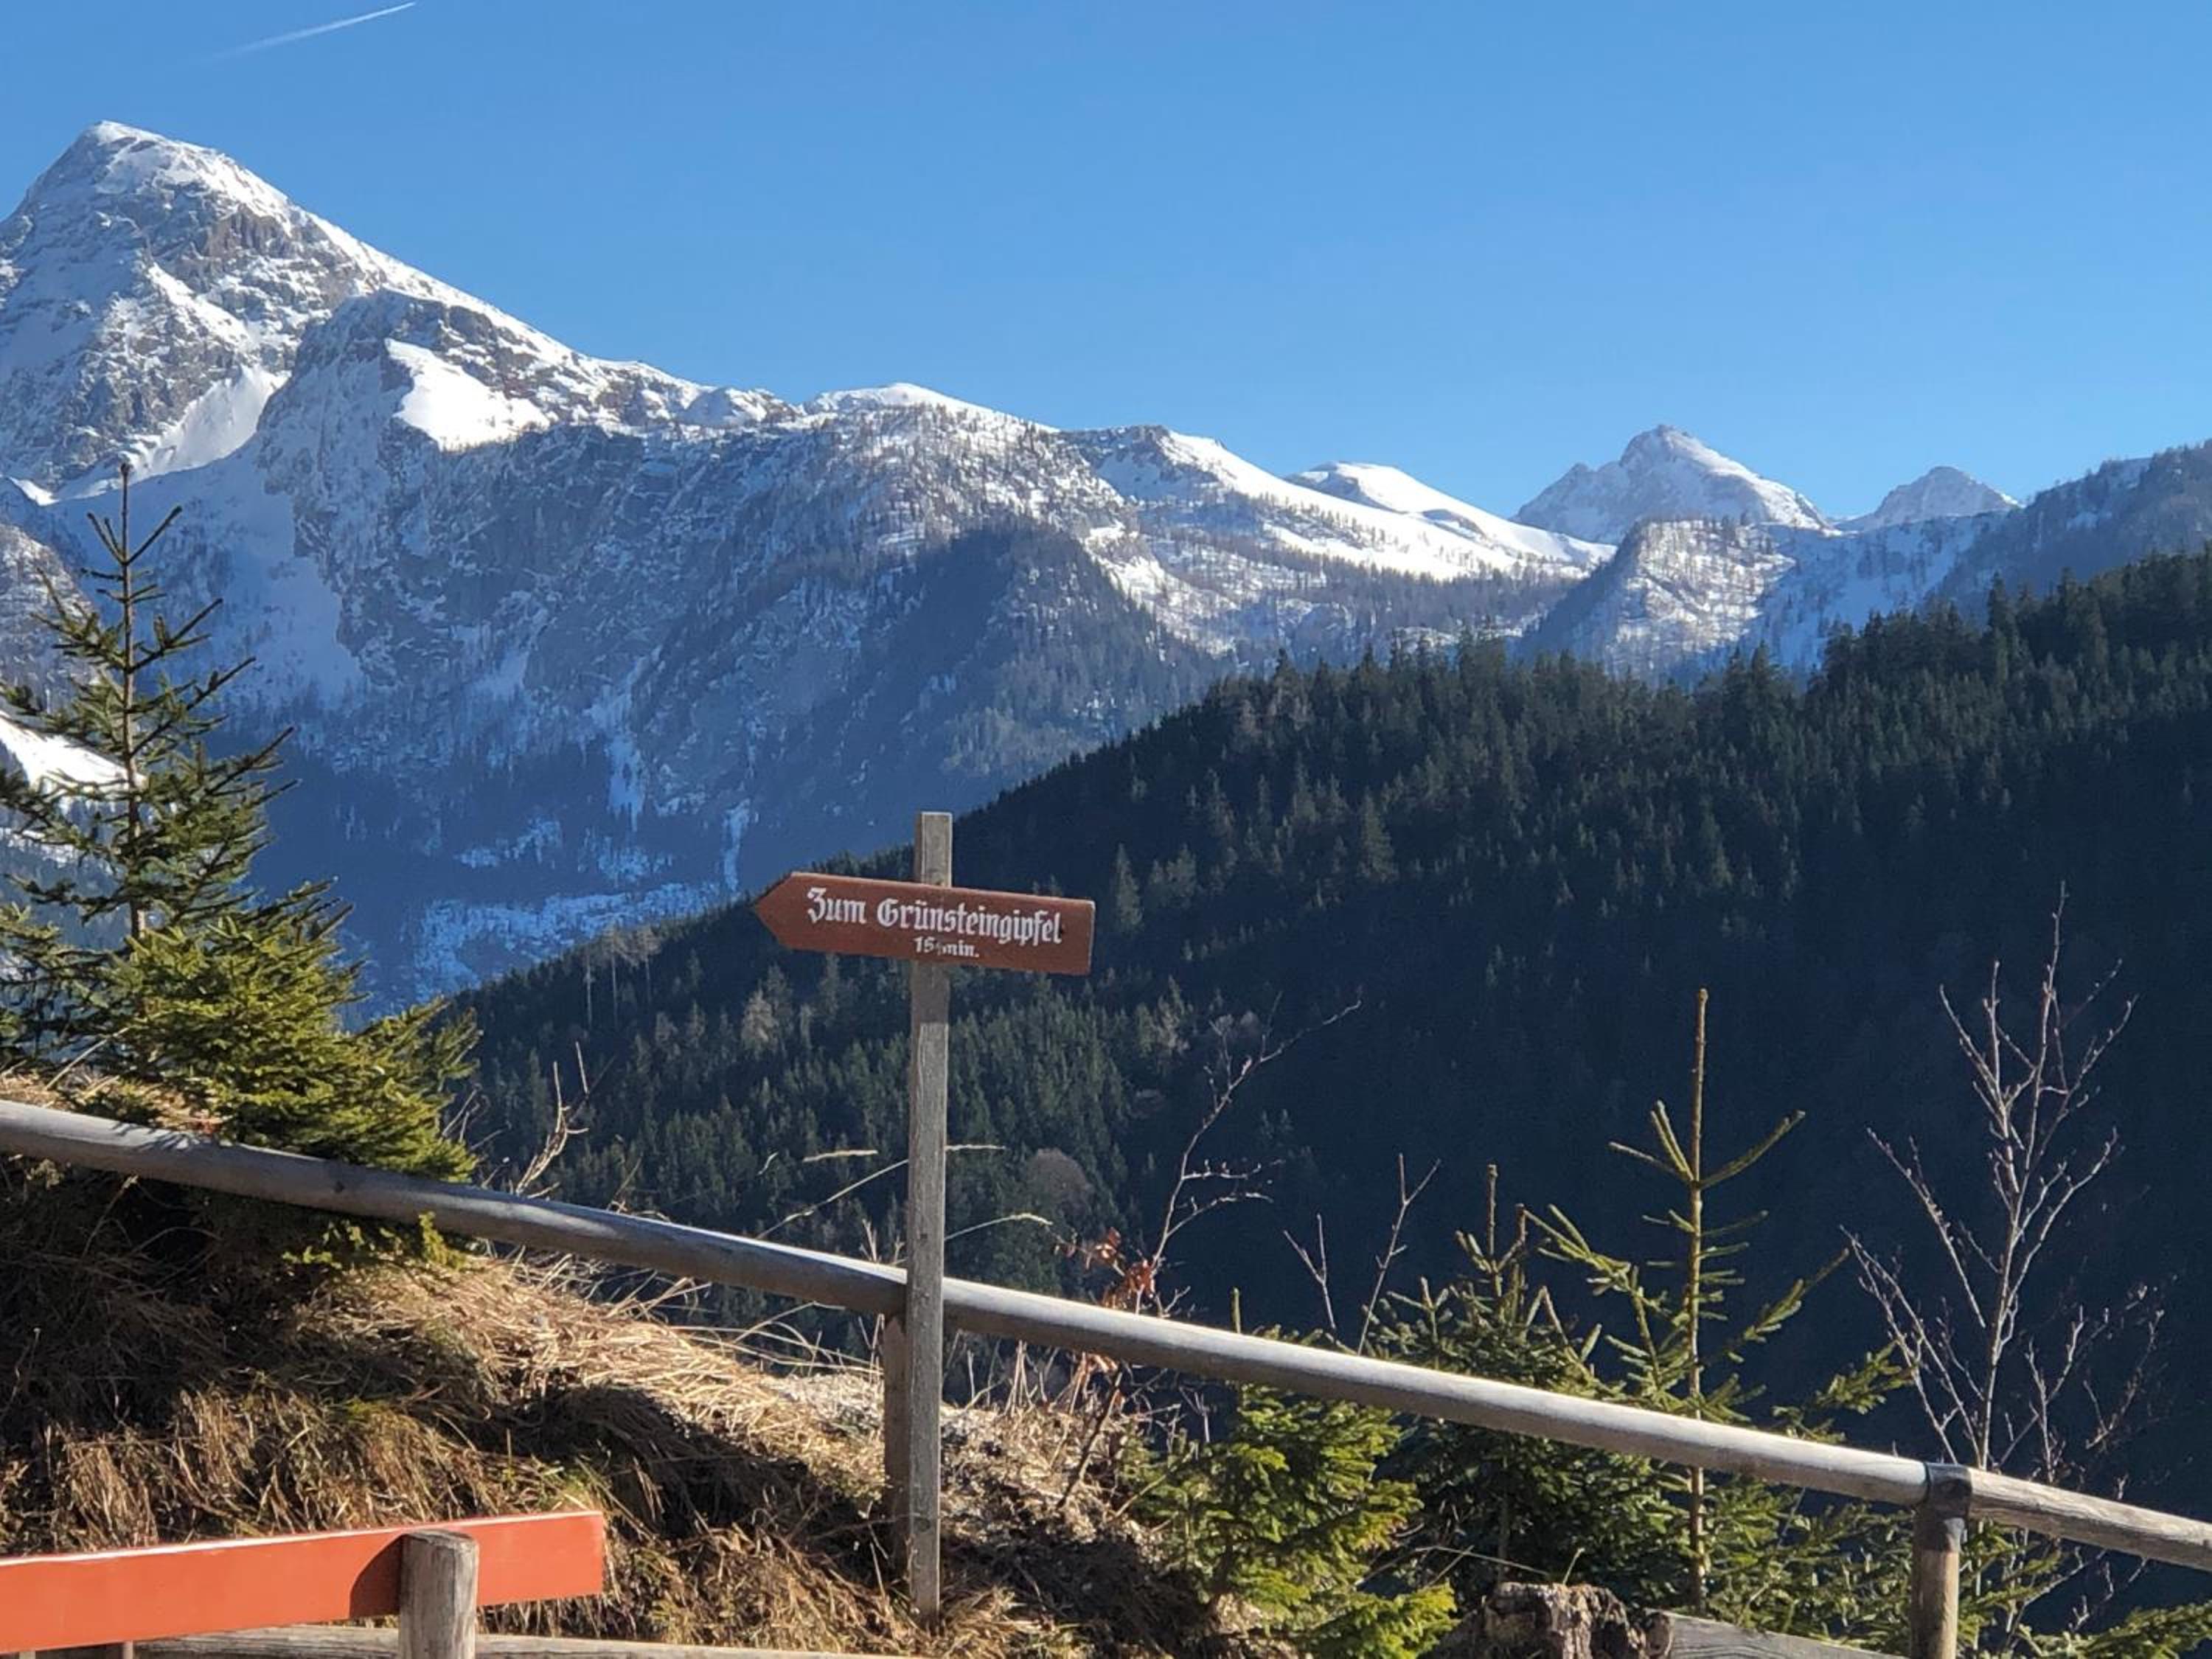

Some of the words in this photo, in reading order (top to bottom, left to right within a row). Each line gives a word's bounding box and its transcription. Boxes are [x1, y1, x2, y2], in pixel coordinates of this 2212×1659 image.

[807, 887, 866, 924] Zum
[877, 897, 1062, 945] Grünsteingipfel
[914, 936, 934, 953] 15
